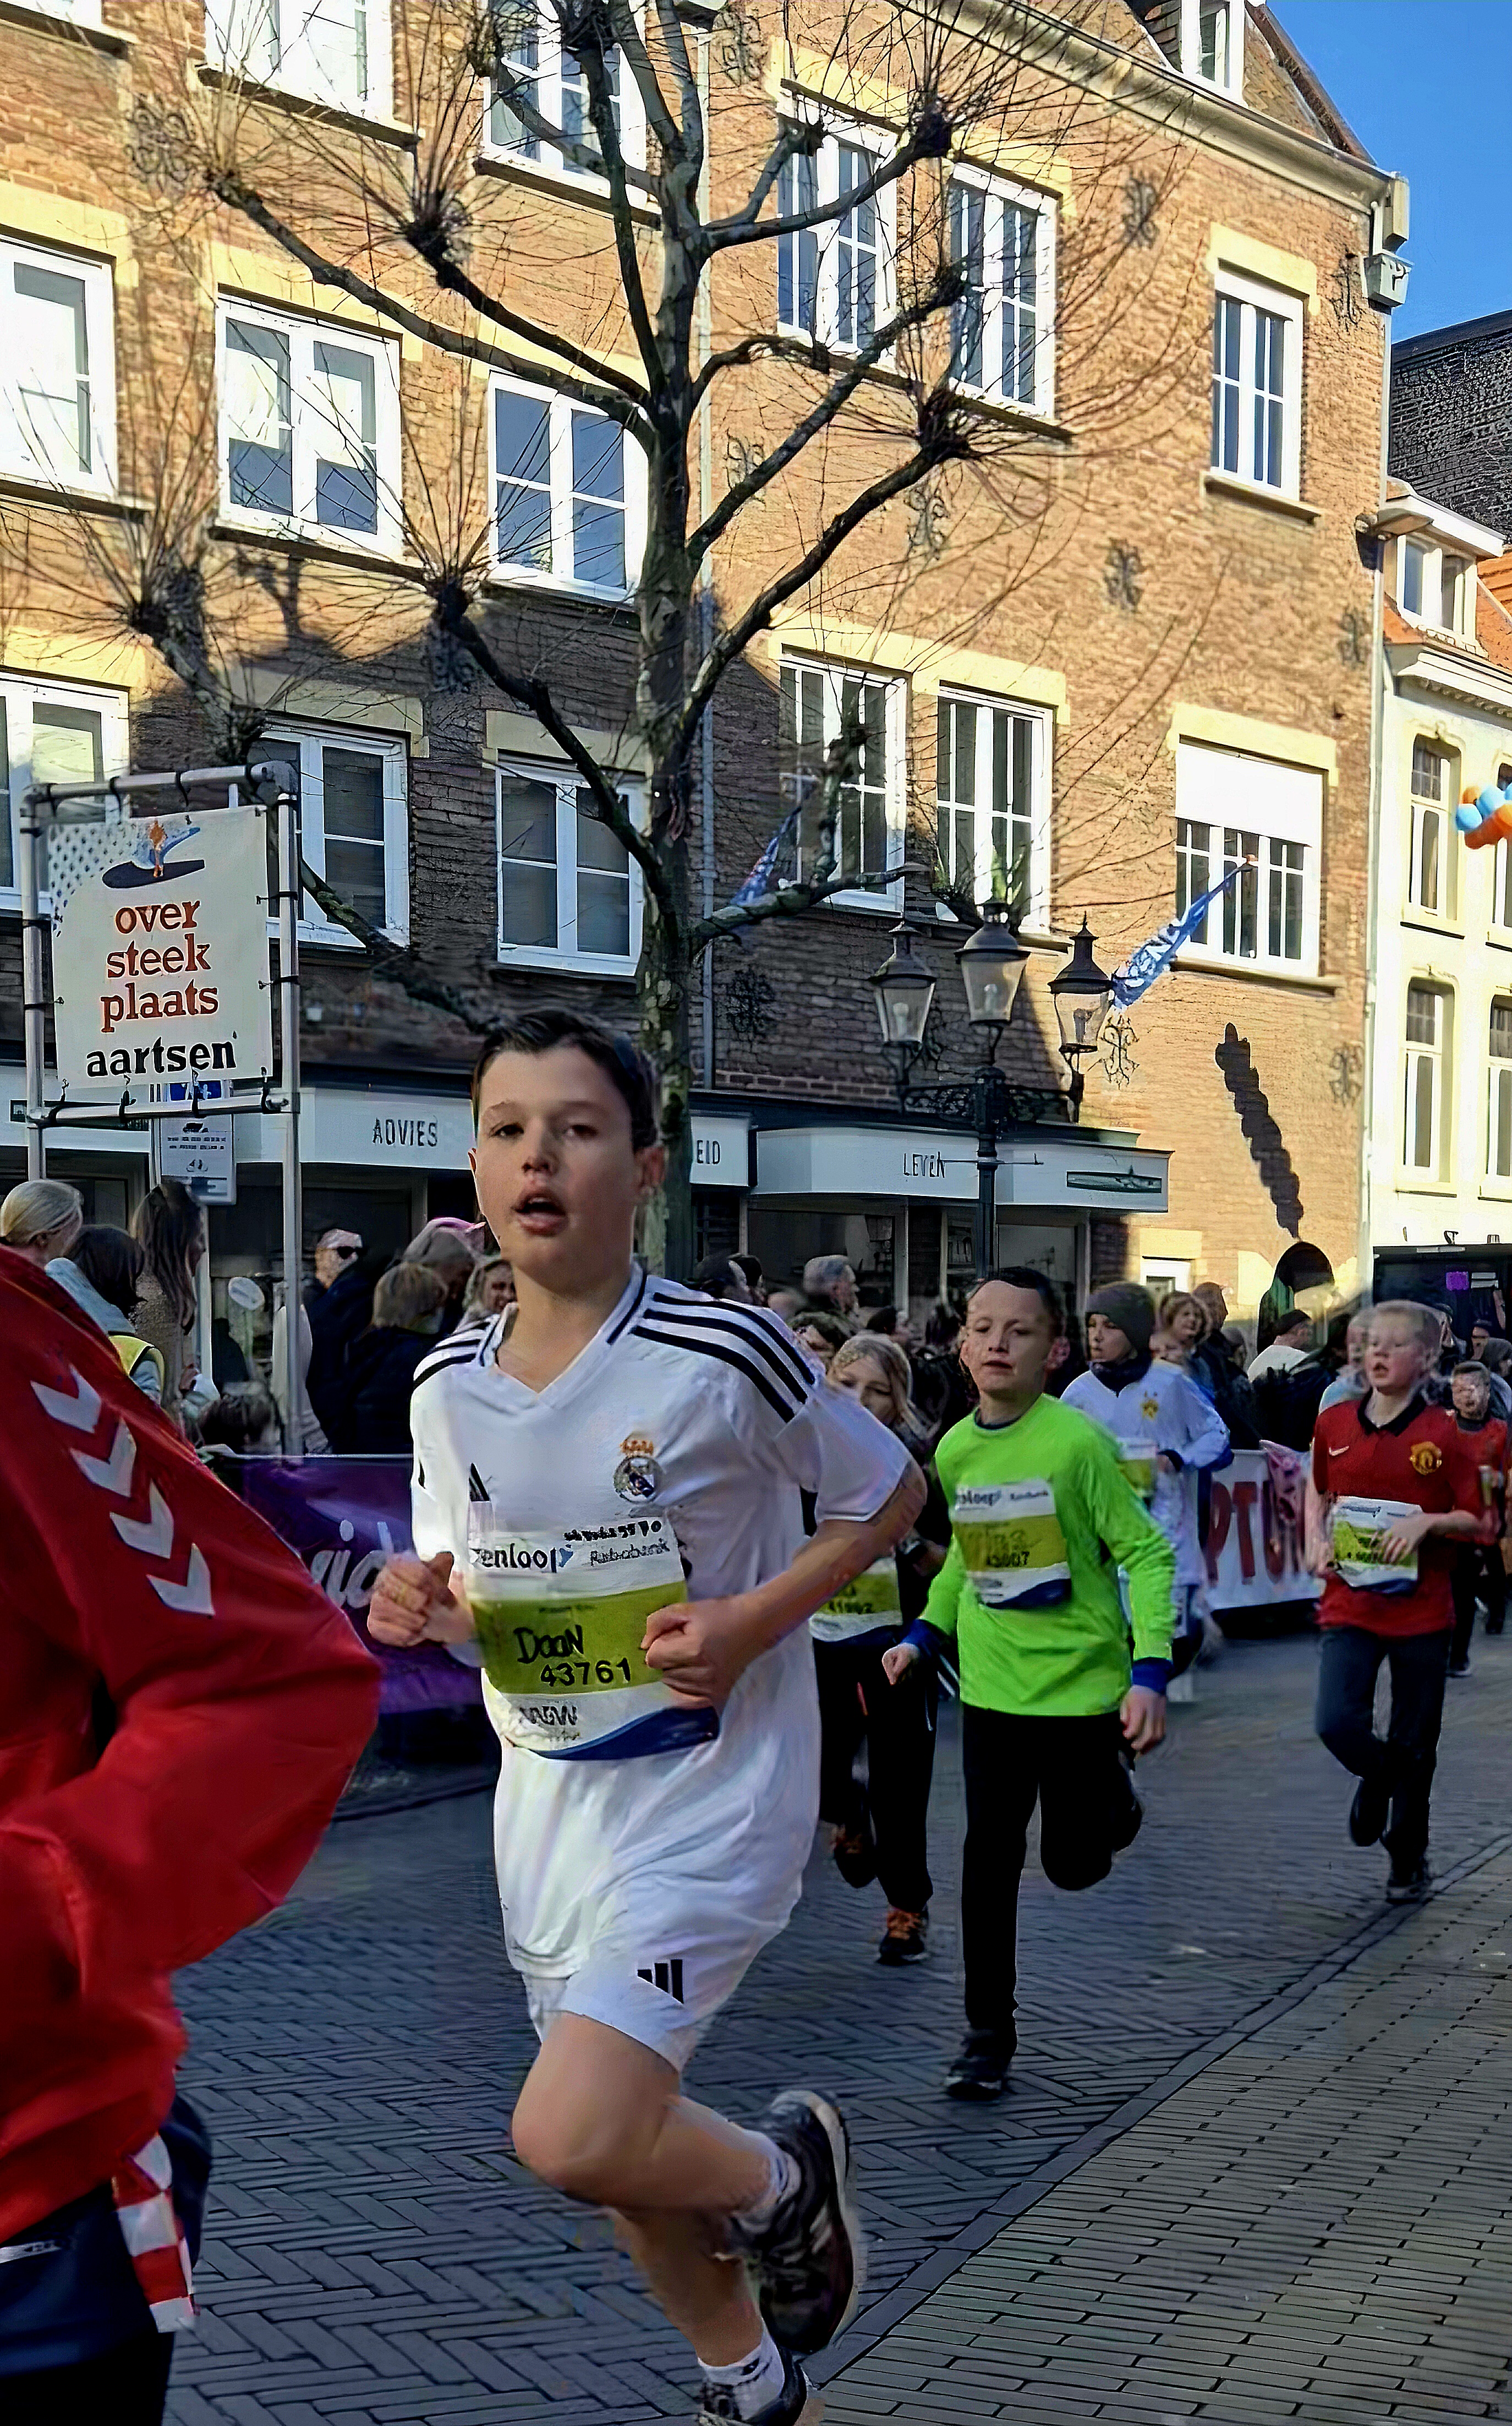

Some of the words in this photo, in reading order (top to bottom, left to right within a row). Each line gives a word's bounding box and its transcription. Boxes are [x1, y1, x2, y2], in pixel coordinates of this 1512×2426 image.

[115, 900, 200, 934] over
[107, 933, 211, 978] steek
[100, 979, 218, 1033] plaats
[86, 1037, 237, 1077] aartsen
[372, 1118, 437, 1146] ADVIES
[697, 1140, 721, 1164] EID
[540, 1658, 631, 1687] 43761
